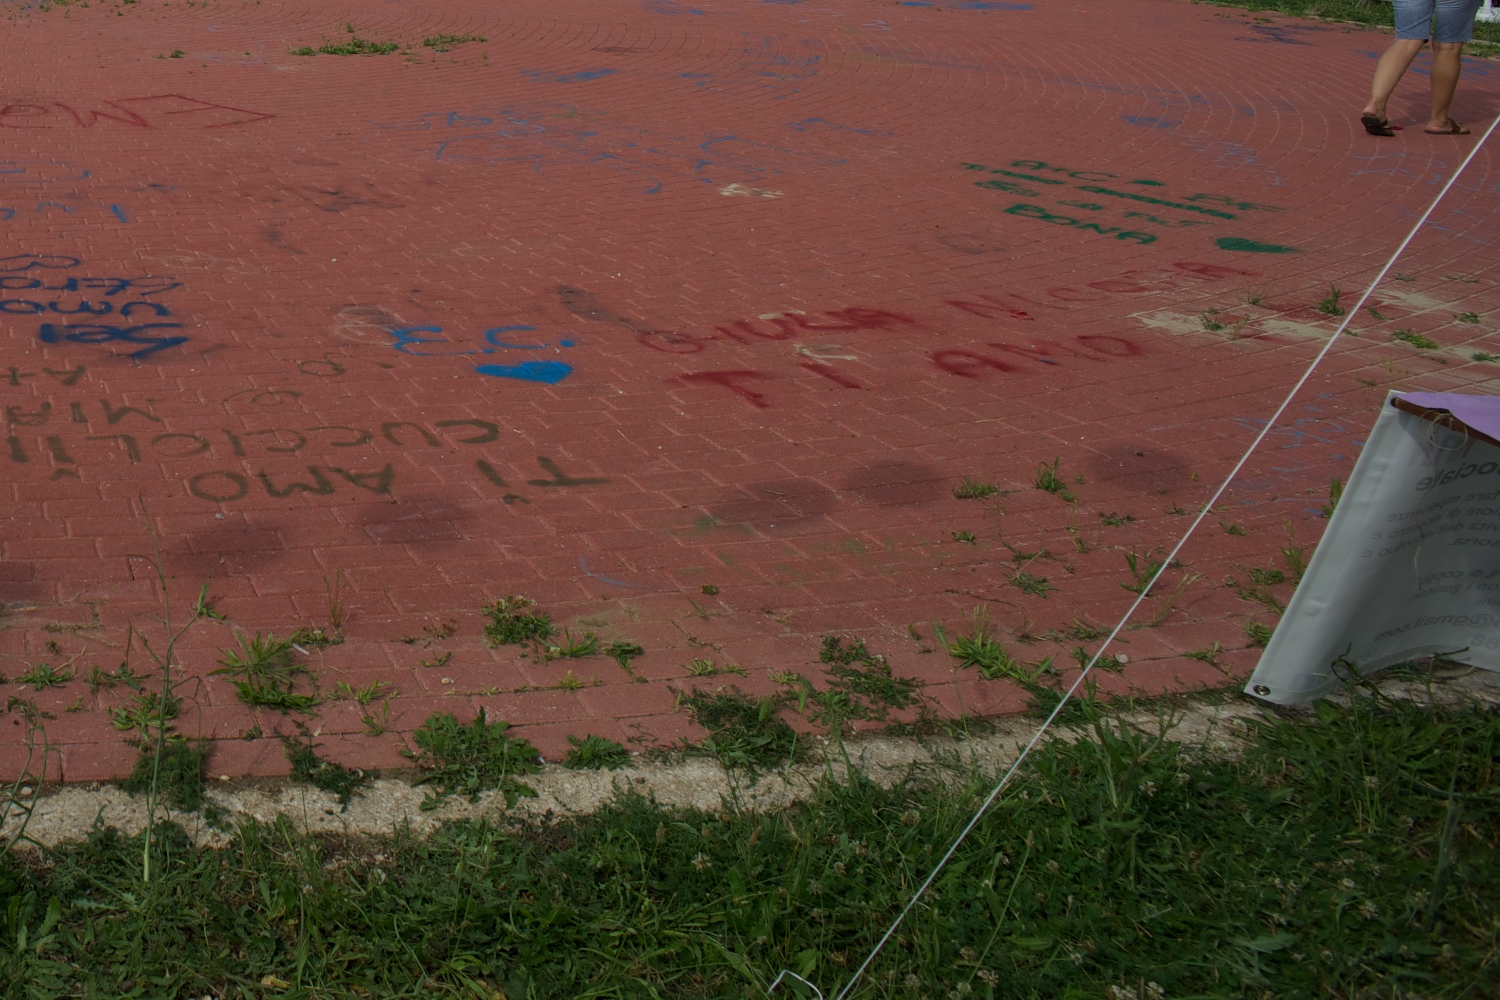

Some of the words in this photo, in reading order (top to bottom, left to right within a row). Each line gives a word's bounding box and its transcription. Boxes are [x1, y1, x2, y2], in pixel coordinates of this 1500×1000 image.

[6, 399, 162, 426] MIA
[190, 463, 393, 502] AMO
[475, 457, 610, 505] TI
